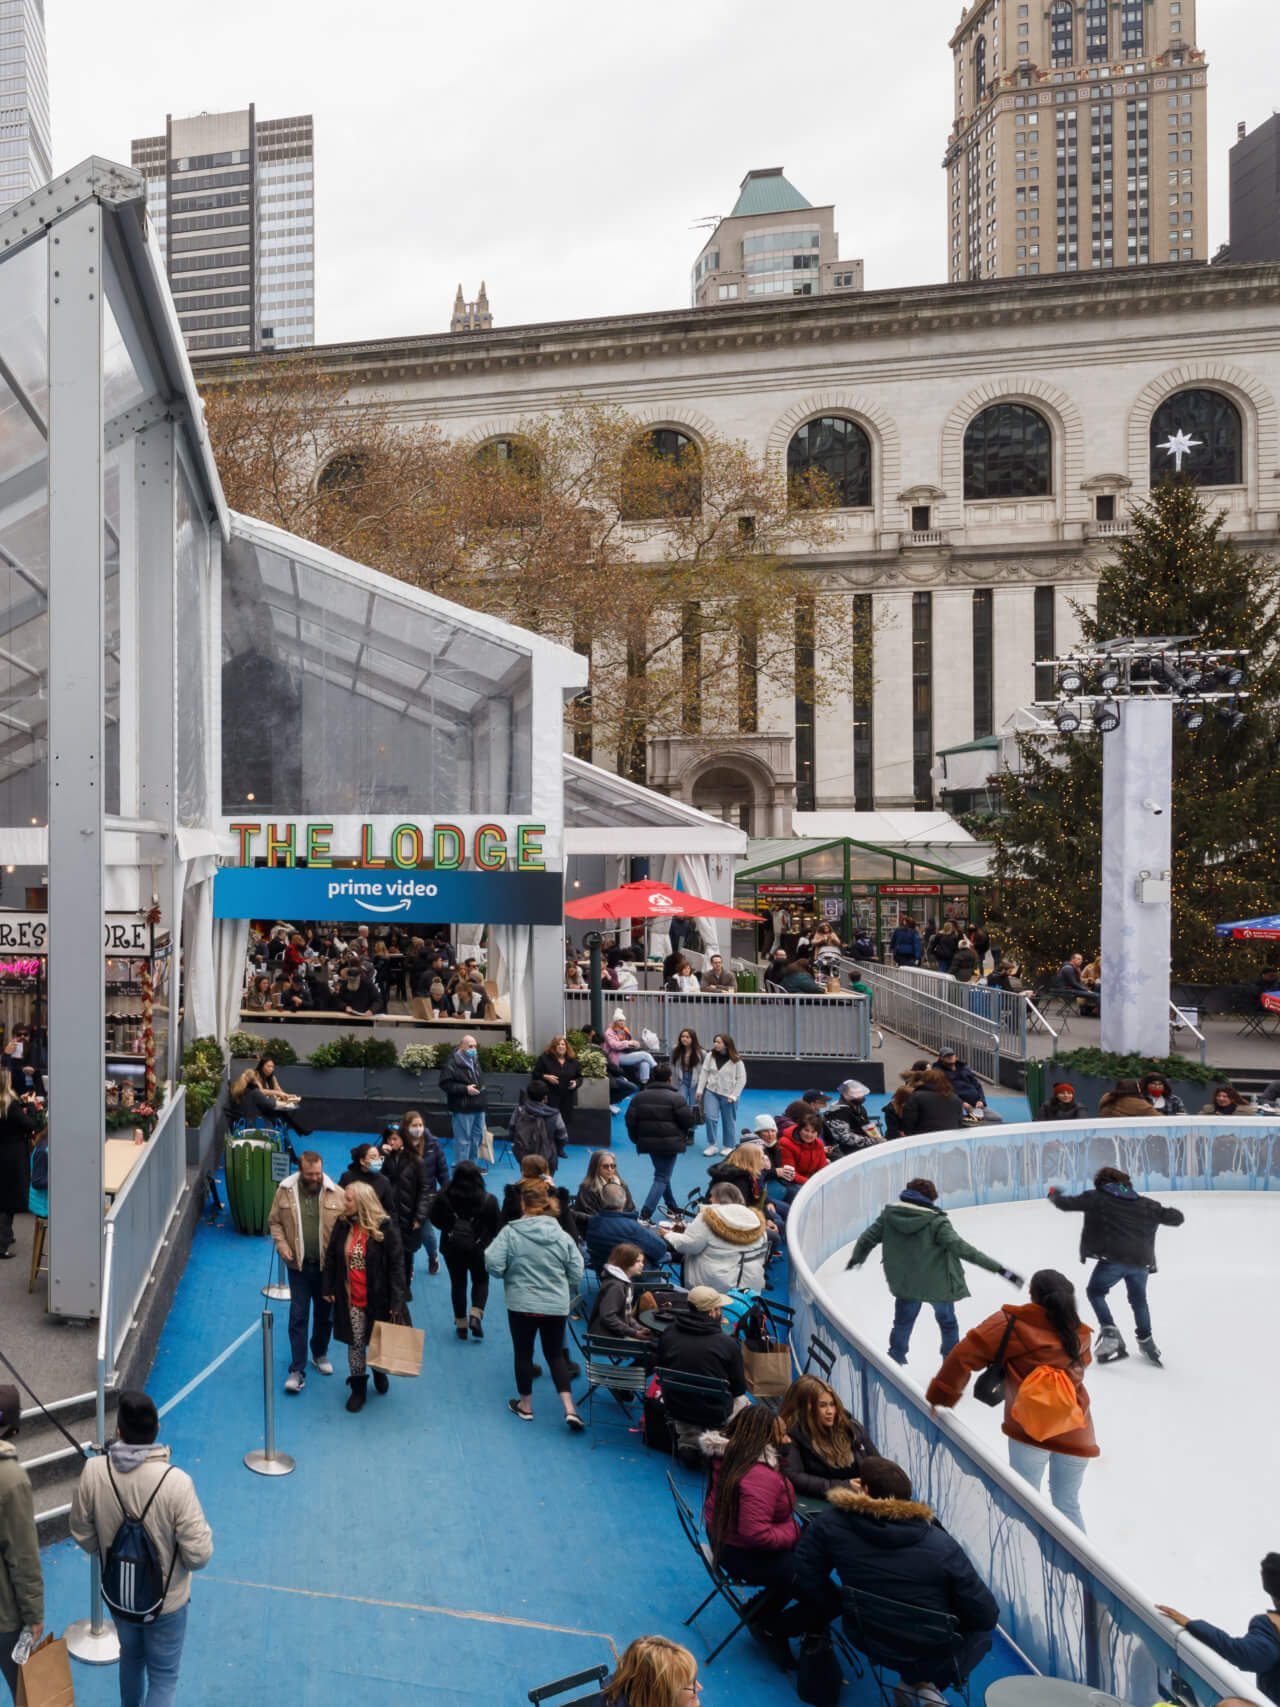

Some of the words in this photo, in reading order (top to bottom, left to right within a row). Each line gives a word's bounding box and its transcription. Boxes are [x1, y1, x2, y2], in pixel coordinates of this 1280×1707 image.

[229, 823, 333, 868] THE
[361, 824, 546, 871] LODGE
[328, 879, 382, 898] prime
[386, 879, 438, 897] video
